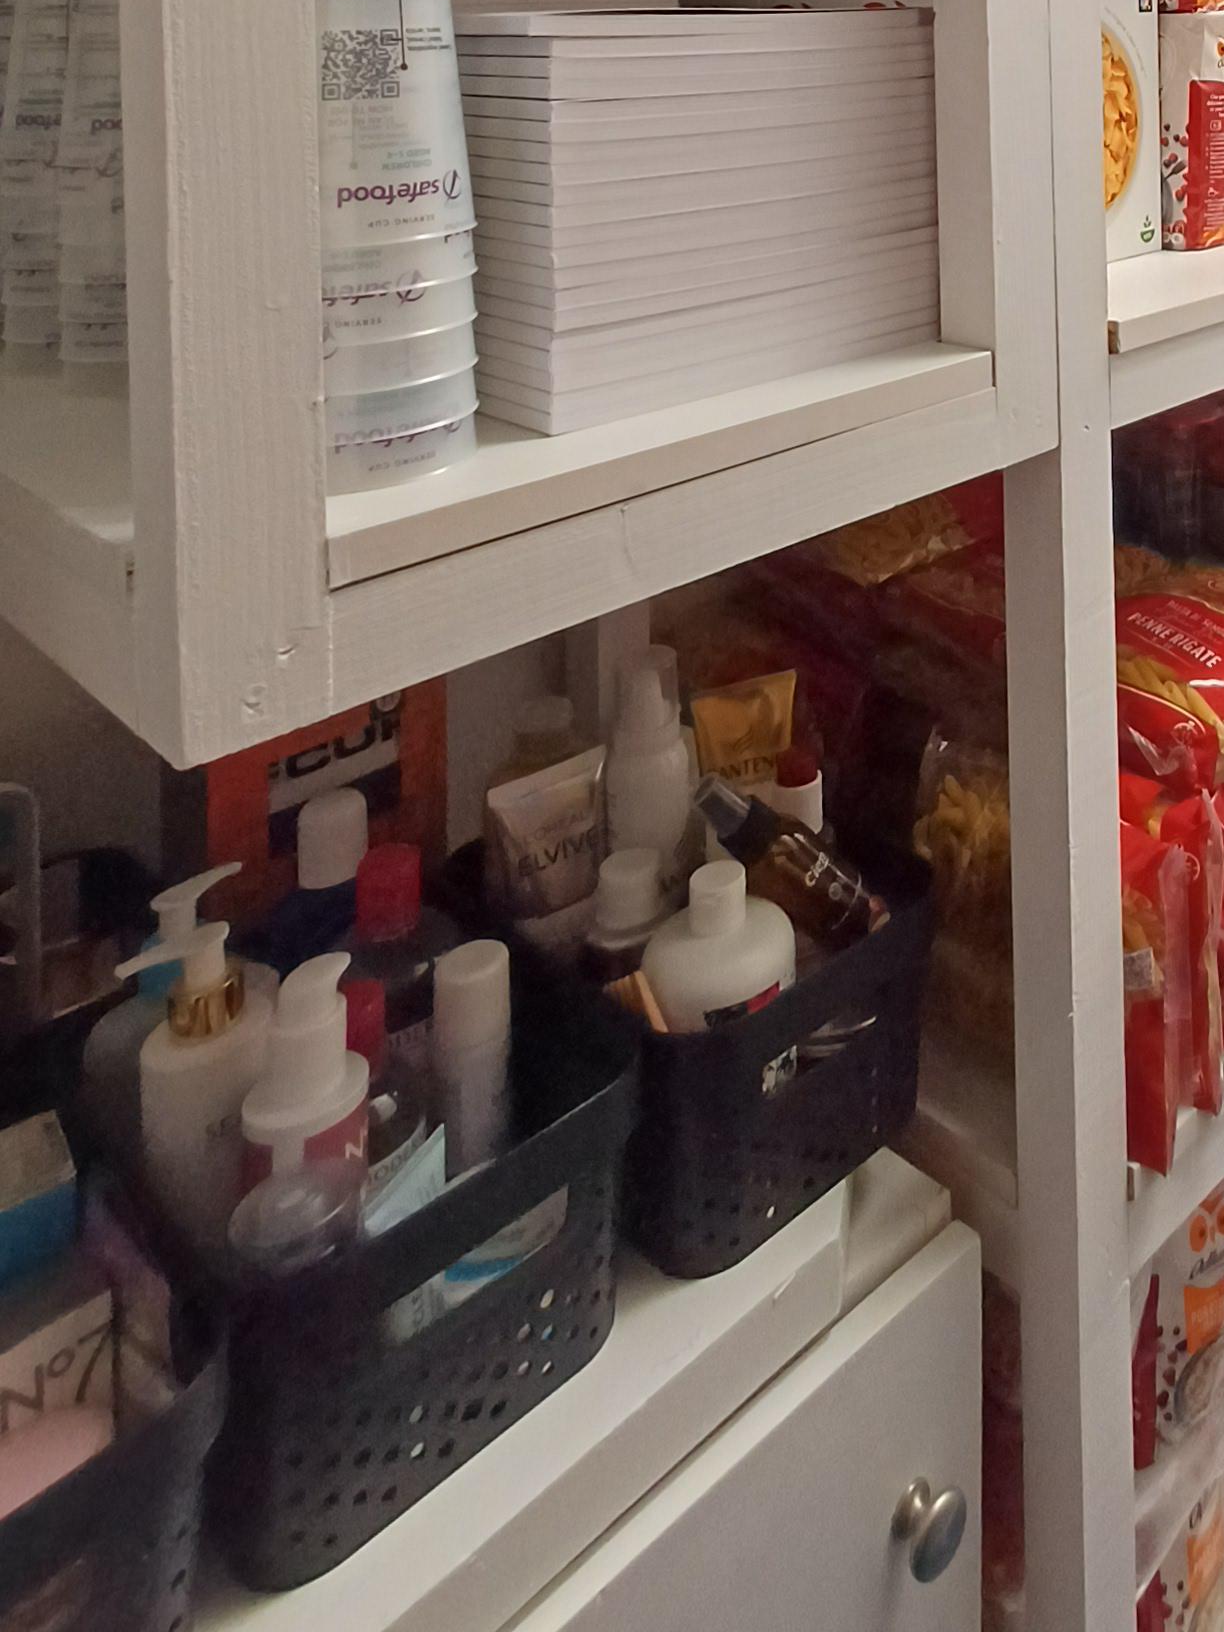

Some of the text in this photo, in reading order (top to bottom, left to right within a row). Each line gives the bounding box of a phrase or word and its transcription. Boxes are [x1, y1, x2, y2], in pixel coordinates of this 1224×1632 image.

[336, 176, 440, 208] safefood
[367, 218, 391, 229] CUP
[1127, 611, 1223, 669] PENNE RIGATE
